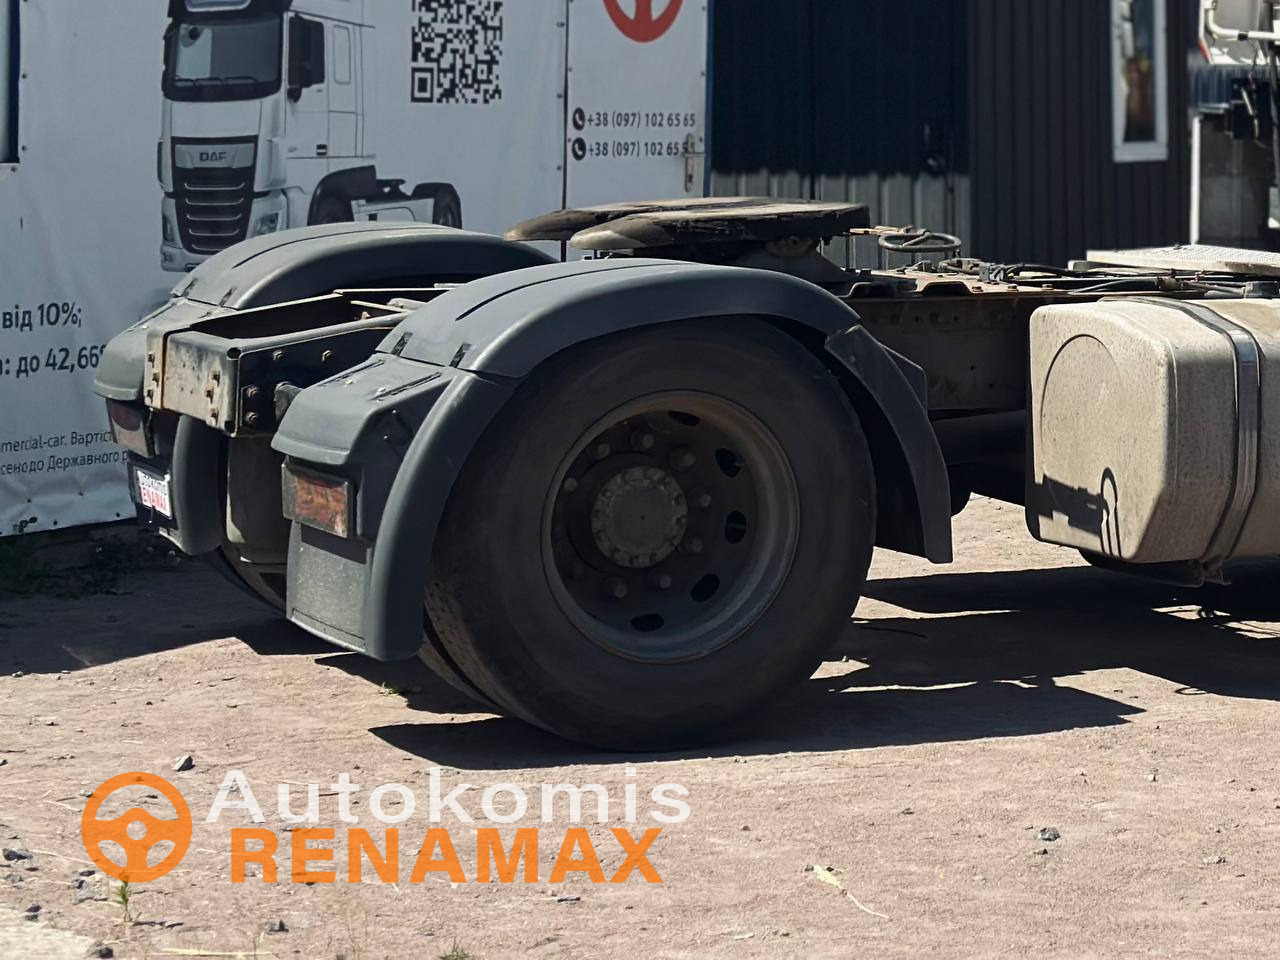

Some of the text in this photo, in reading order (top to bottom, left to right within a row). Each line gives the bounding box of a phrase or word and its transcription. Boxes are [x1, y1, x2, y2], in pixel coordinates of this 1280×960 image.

[587, 110, 696, 129] +38 (097) 102 65 65
[200, 152, 227, 162] DAF
[588, 142, 609, 158] +38
[612, 141, 640, 159] (097)
[645, 142, 663, 157] 102
[666, 142, 679, 157] 65
[2, 302, 82, 332] від 10%;
[16, 355, 40, 379] до
